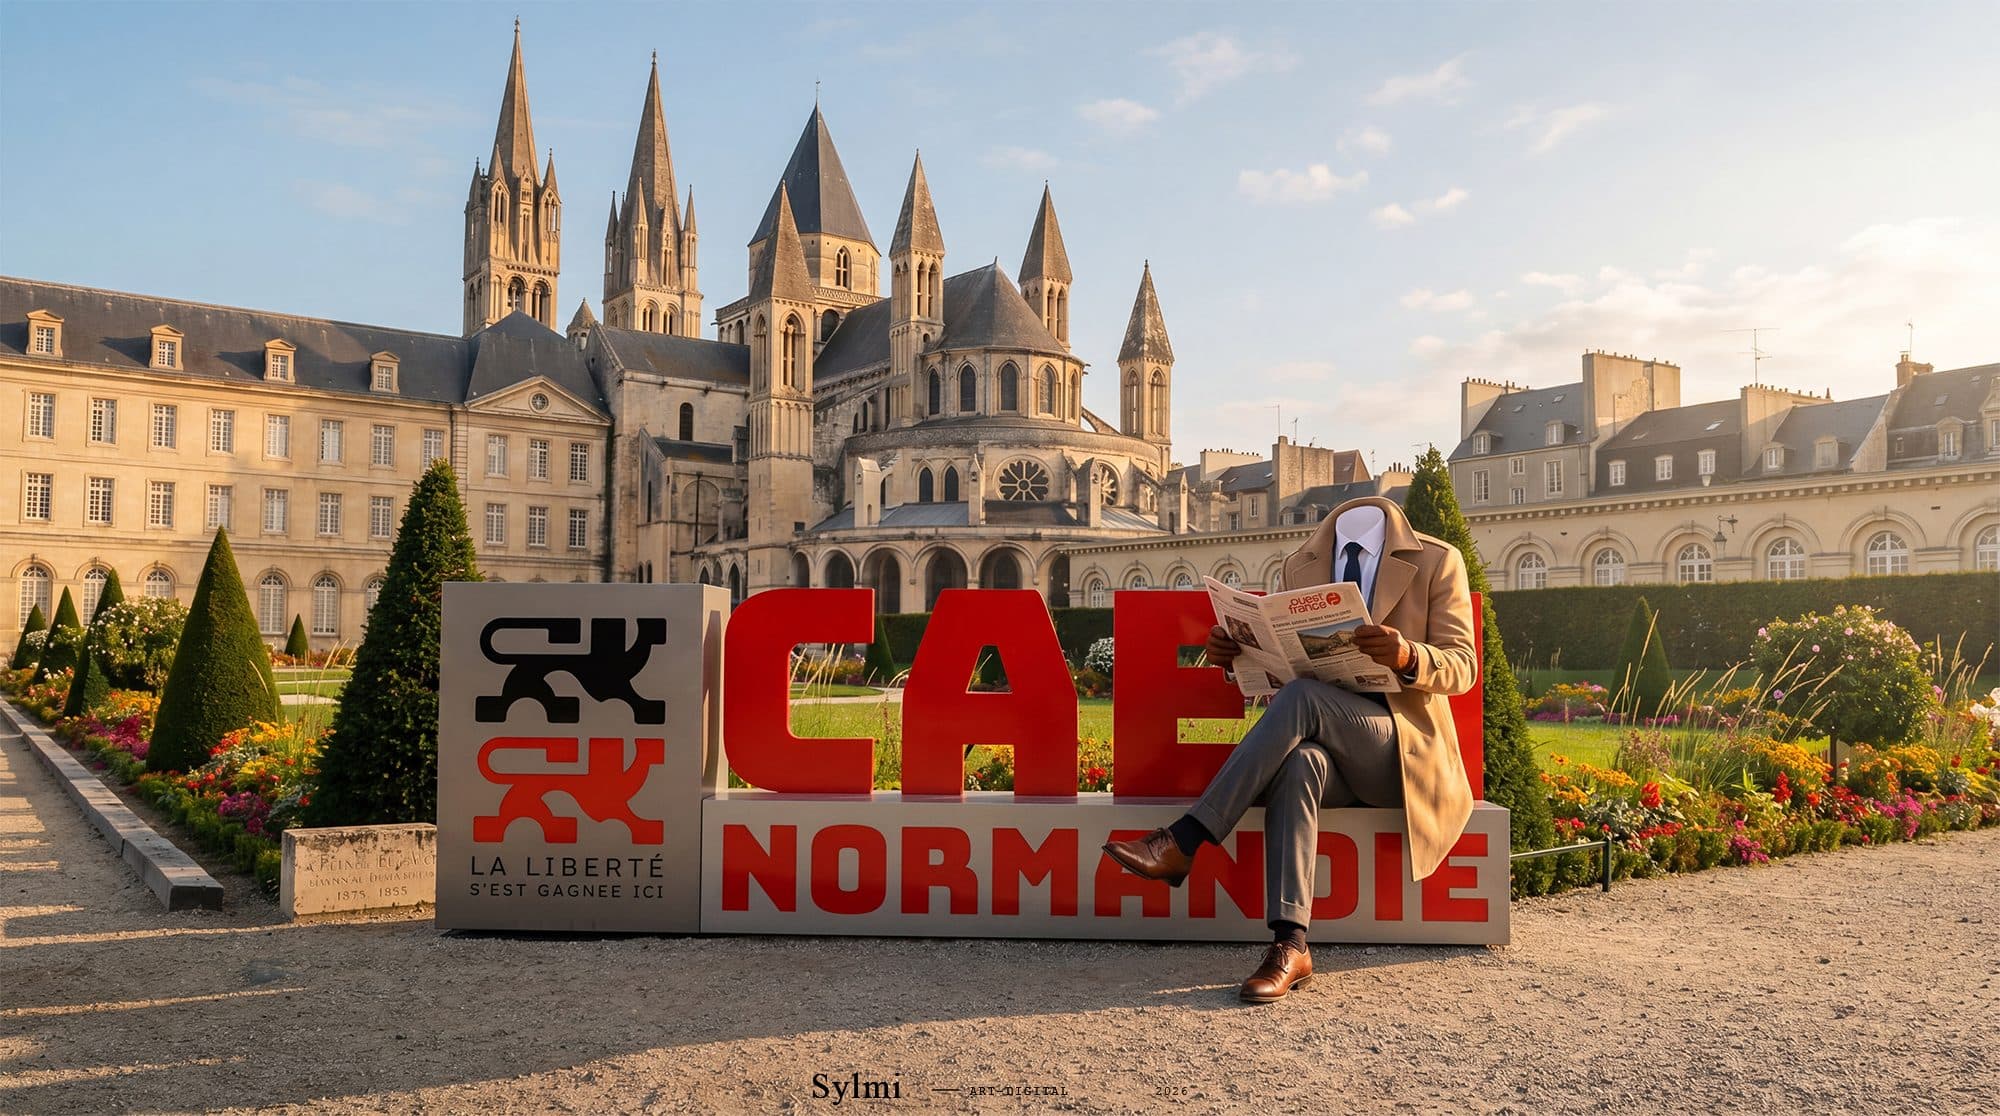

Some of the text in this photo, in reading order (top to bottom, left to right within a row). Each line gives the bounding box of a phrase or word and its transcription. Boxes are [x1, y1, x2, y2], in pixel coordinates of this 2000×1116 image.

[1288, 600, 1327, 614] france
[723, 588, 1484, 801] CAE
[471, 853, 664, 878] LA LIBERTÉ
[470, 883, 664, 898] S'EST GAGNEE ICI
